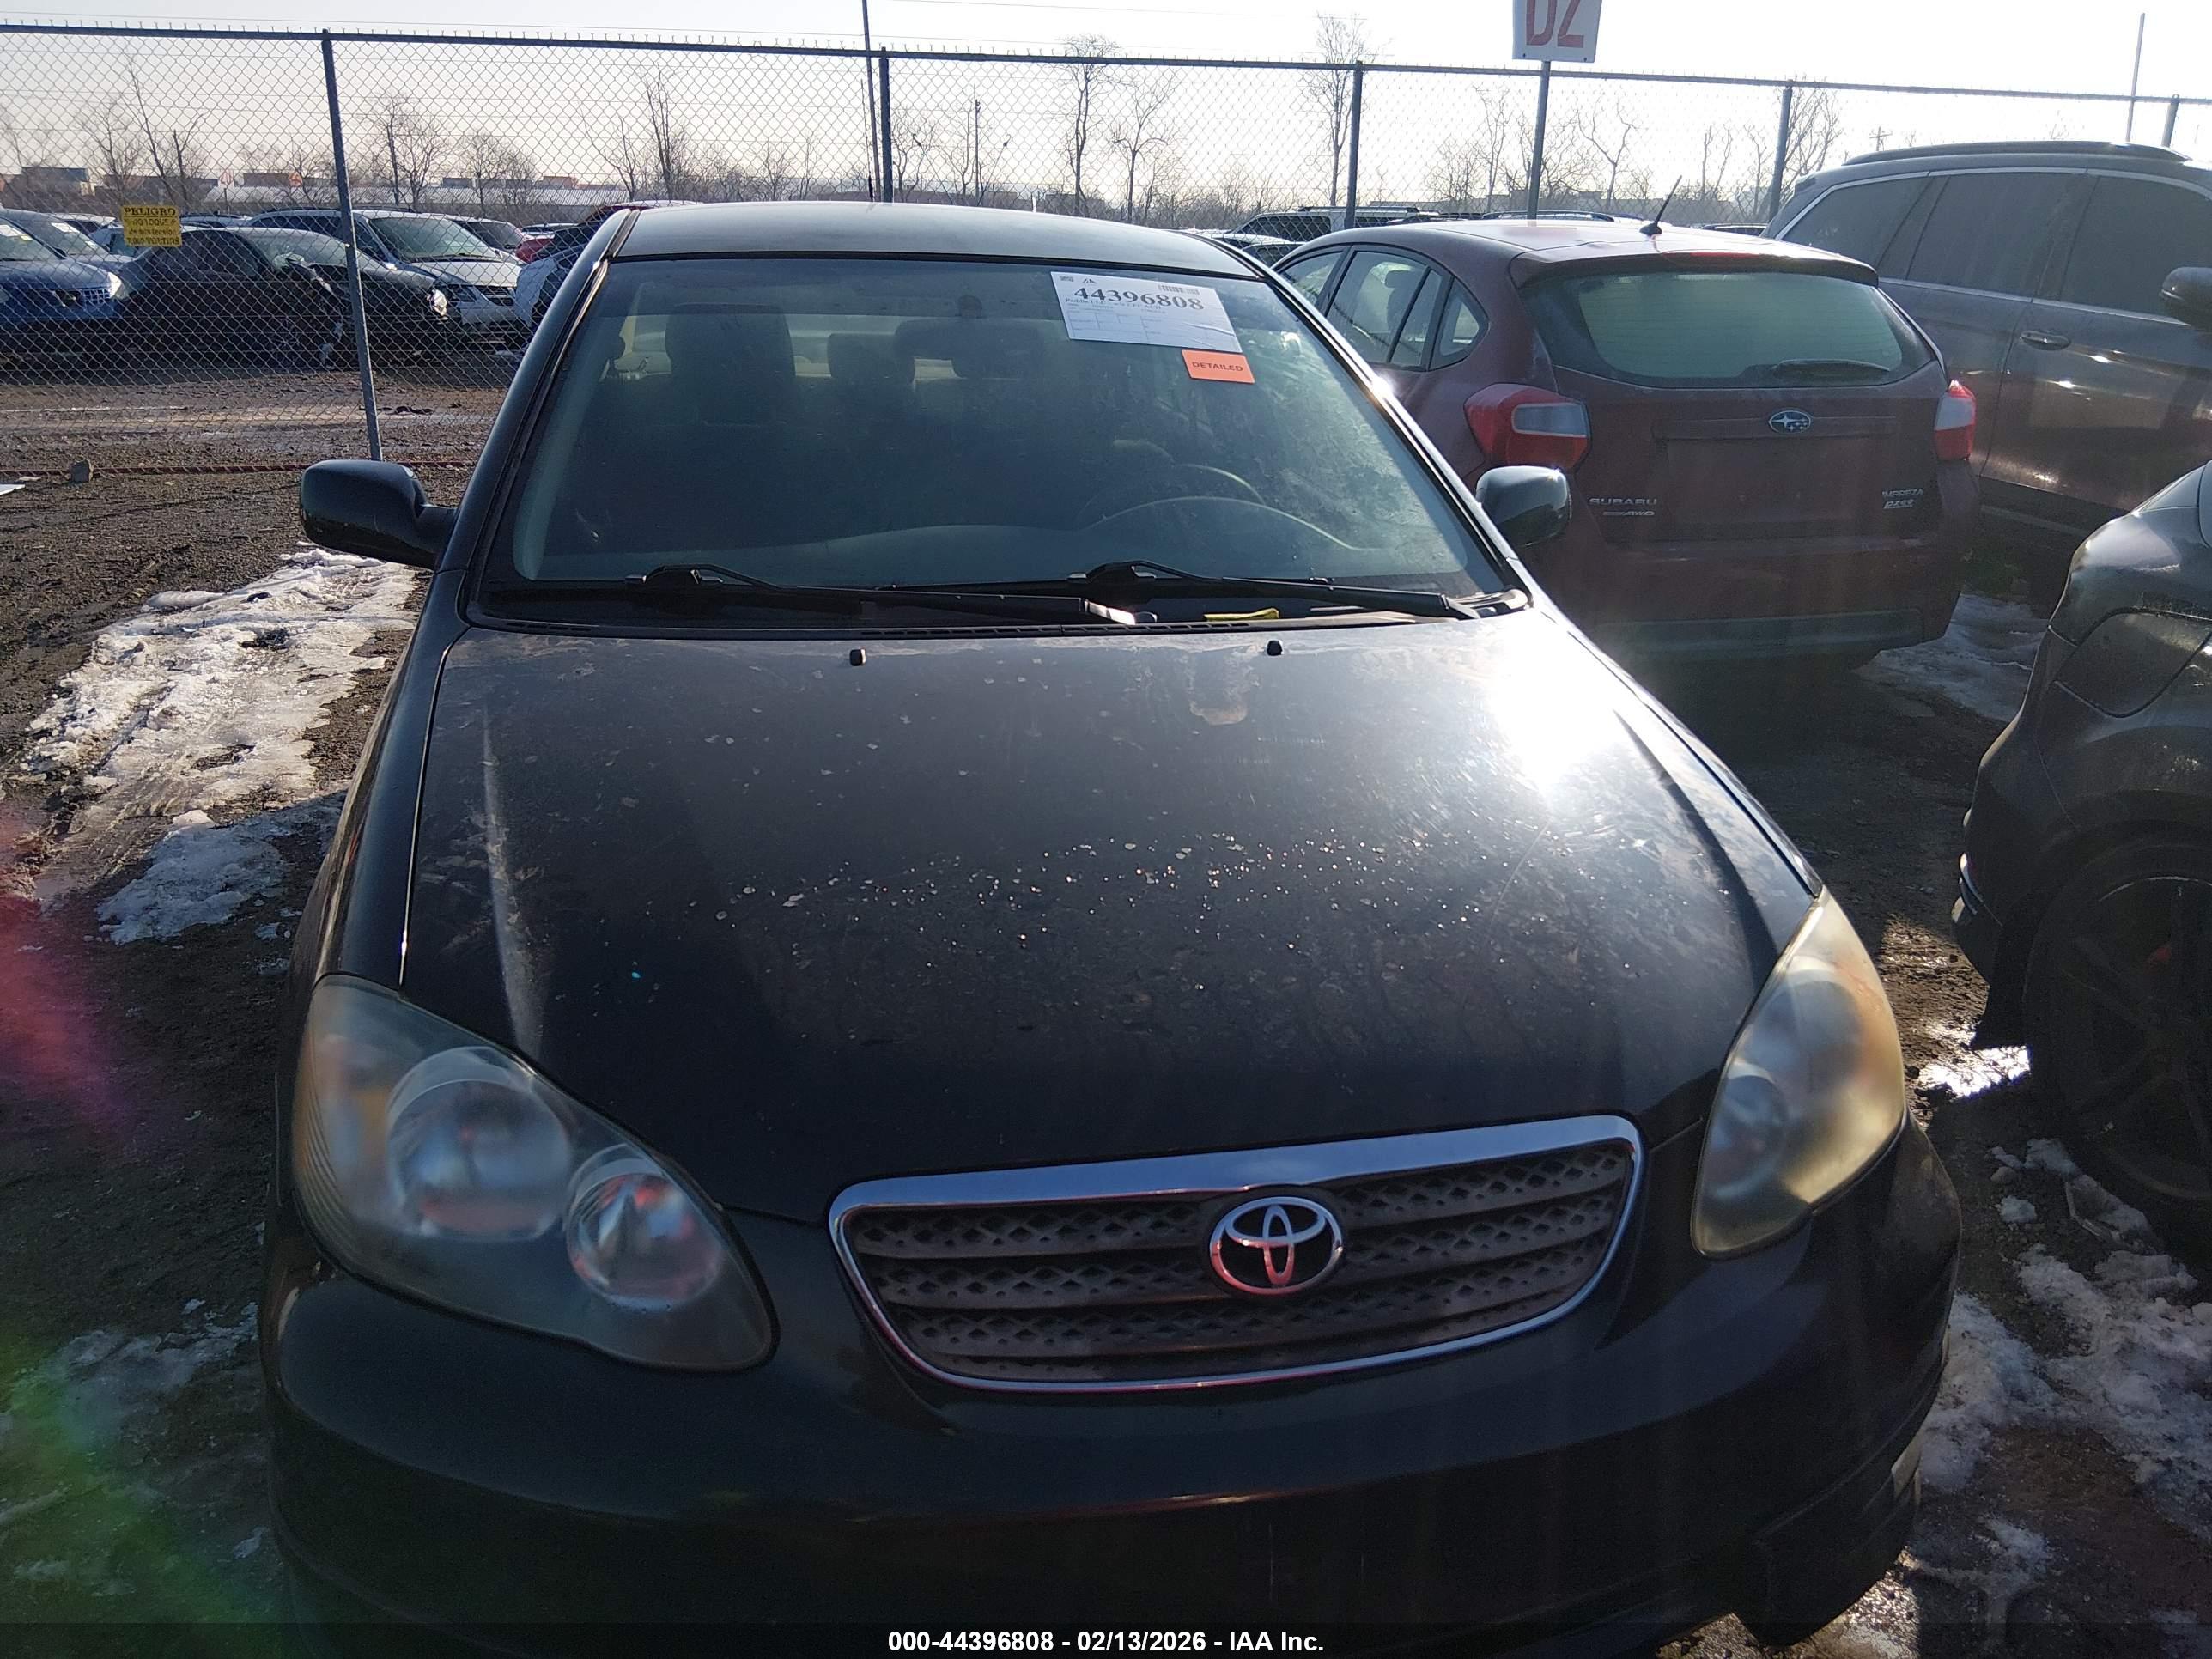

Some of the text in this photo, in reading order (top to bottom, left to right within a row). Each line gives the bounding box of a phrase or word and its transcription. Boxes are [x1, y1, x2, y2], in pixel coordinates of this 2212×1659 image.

[125, 207, 176, 216] PELIGRO
[1074, 287, 1204, 310] 44396808
[1192, 362, 1243, 372] DETAILED
